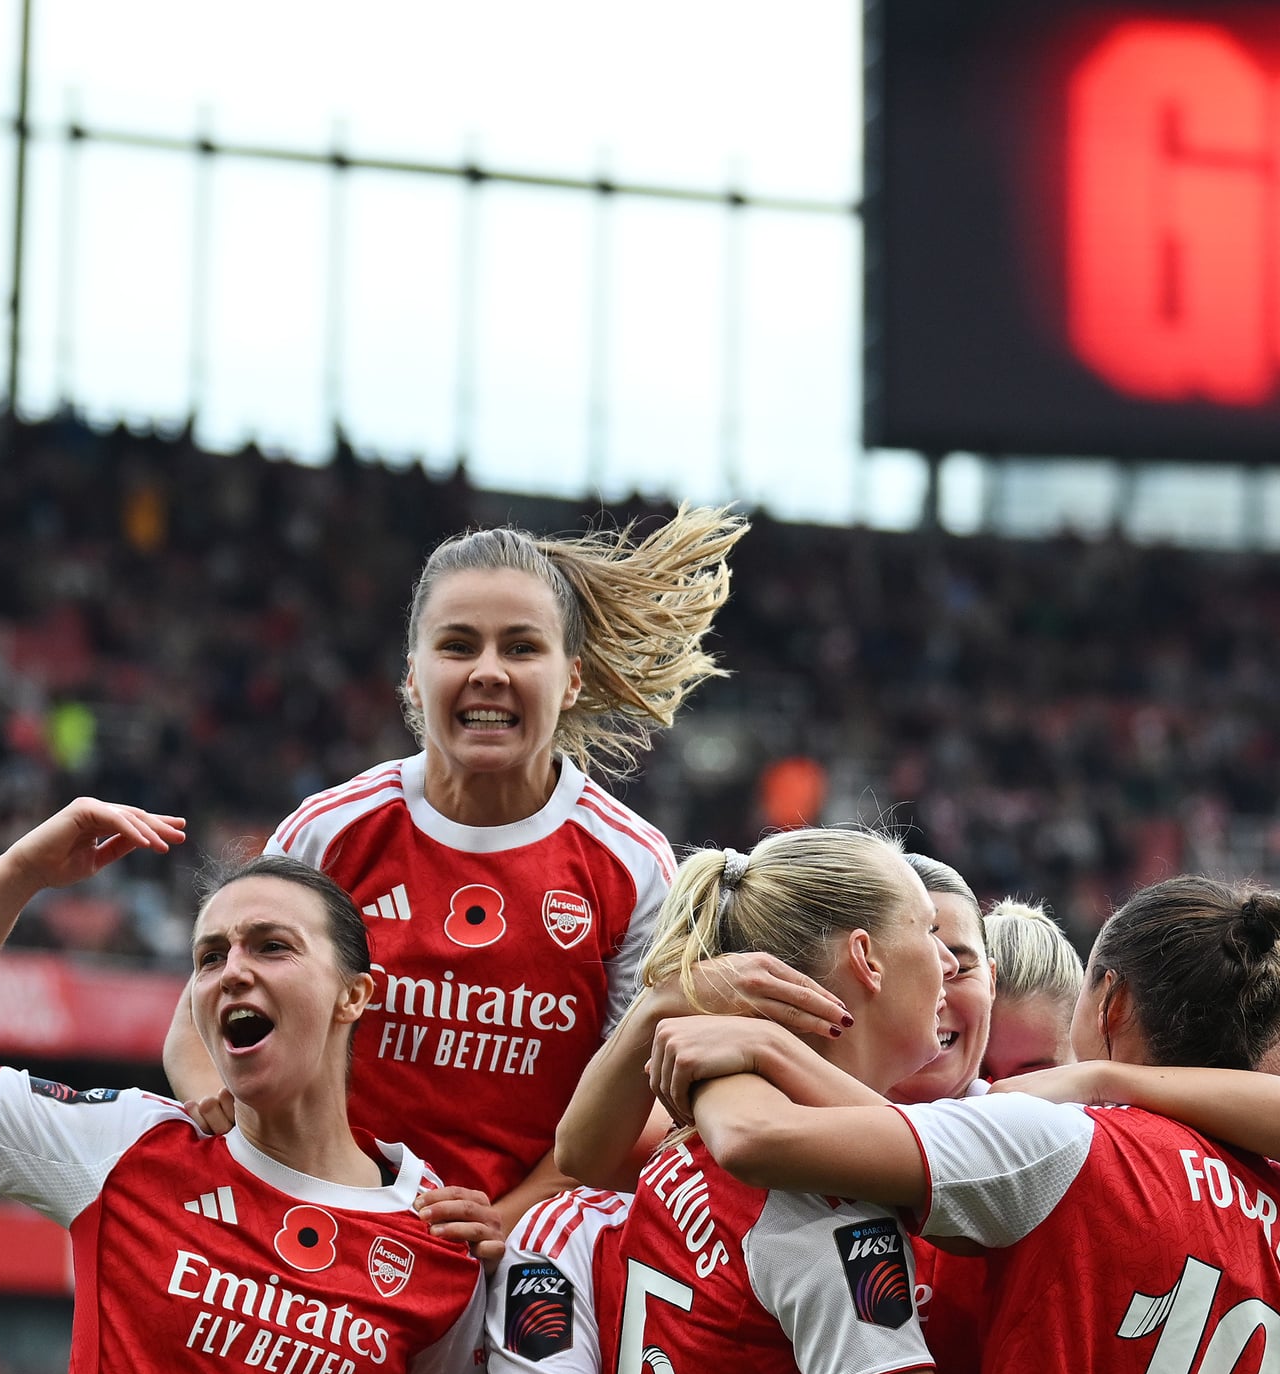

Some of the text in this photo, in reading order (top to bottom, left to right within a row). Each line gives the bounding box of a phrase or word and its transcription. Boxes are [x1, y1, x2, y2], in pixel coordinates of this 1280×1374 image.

[550, 898, 585, 913] Arsenal
[378, 1022, 542, 1075] FLY BETTER
[376, 1245, 408, 1267] Arsenal
[848, 1234, 900, 1261] WSL
[531, 1268, 559, 1276] BARCLA
[511, 1276, 567, 1296] WSL
[167, 1250, 389, 1365] Emirates
[186, 1311, 241, 1358] FLY
